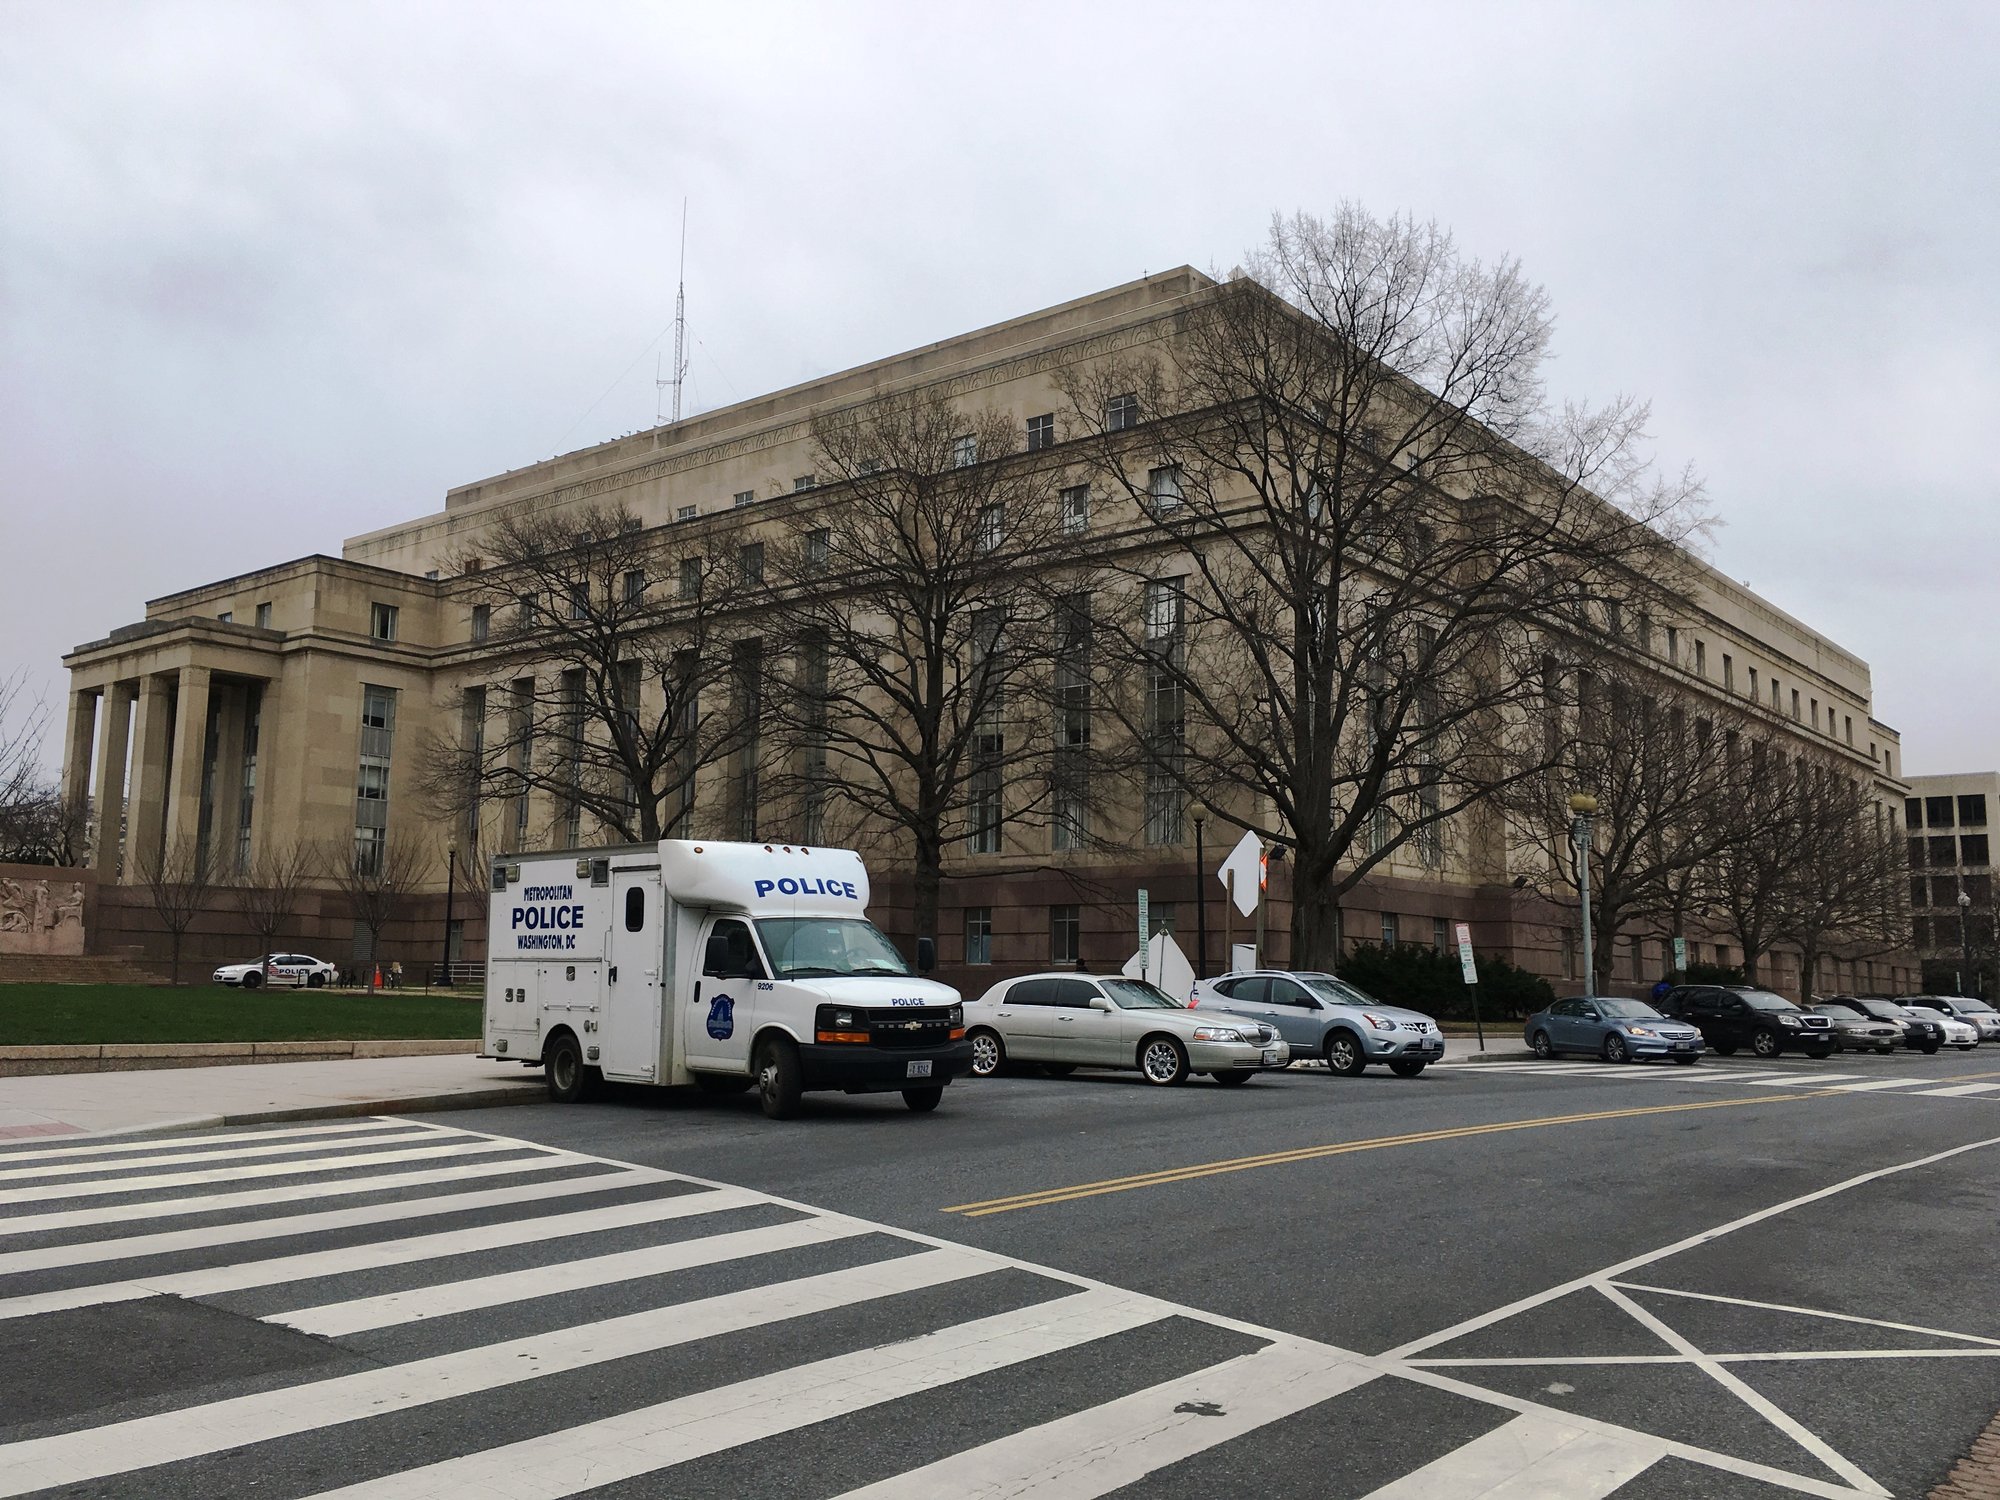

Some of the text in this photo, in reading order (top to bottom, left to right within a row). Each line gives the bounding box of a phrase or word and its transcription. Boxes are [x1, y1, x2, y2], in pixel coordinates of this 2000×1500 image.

[524, 885, 572, 901] METROPOLITAN
[755, 878, 858, 899] POLICE
[512, 905, 584, 929] POLICE
[517, 934, 576, 950] WASHINGTON, DC
[891, 998, 925, 1006] POLICE
